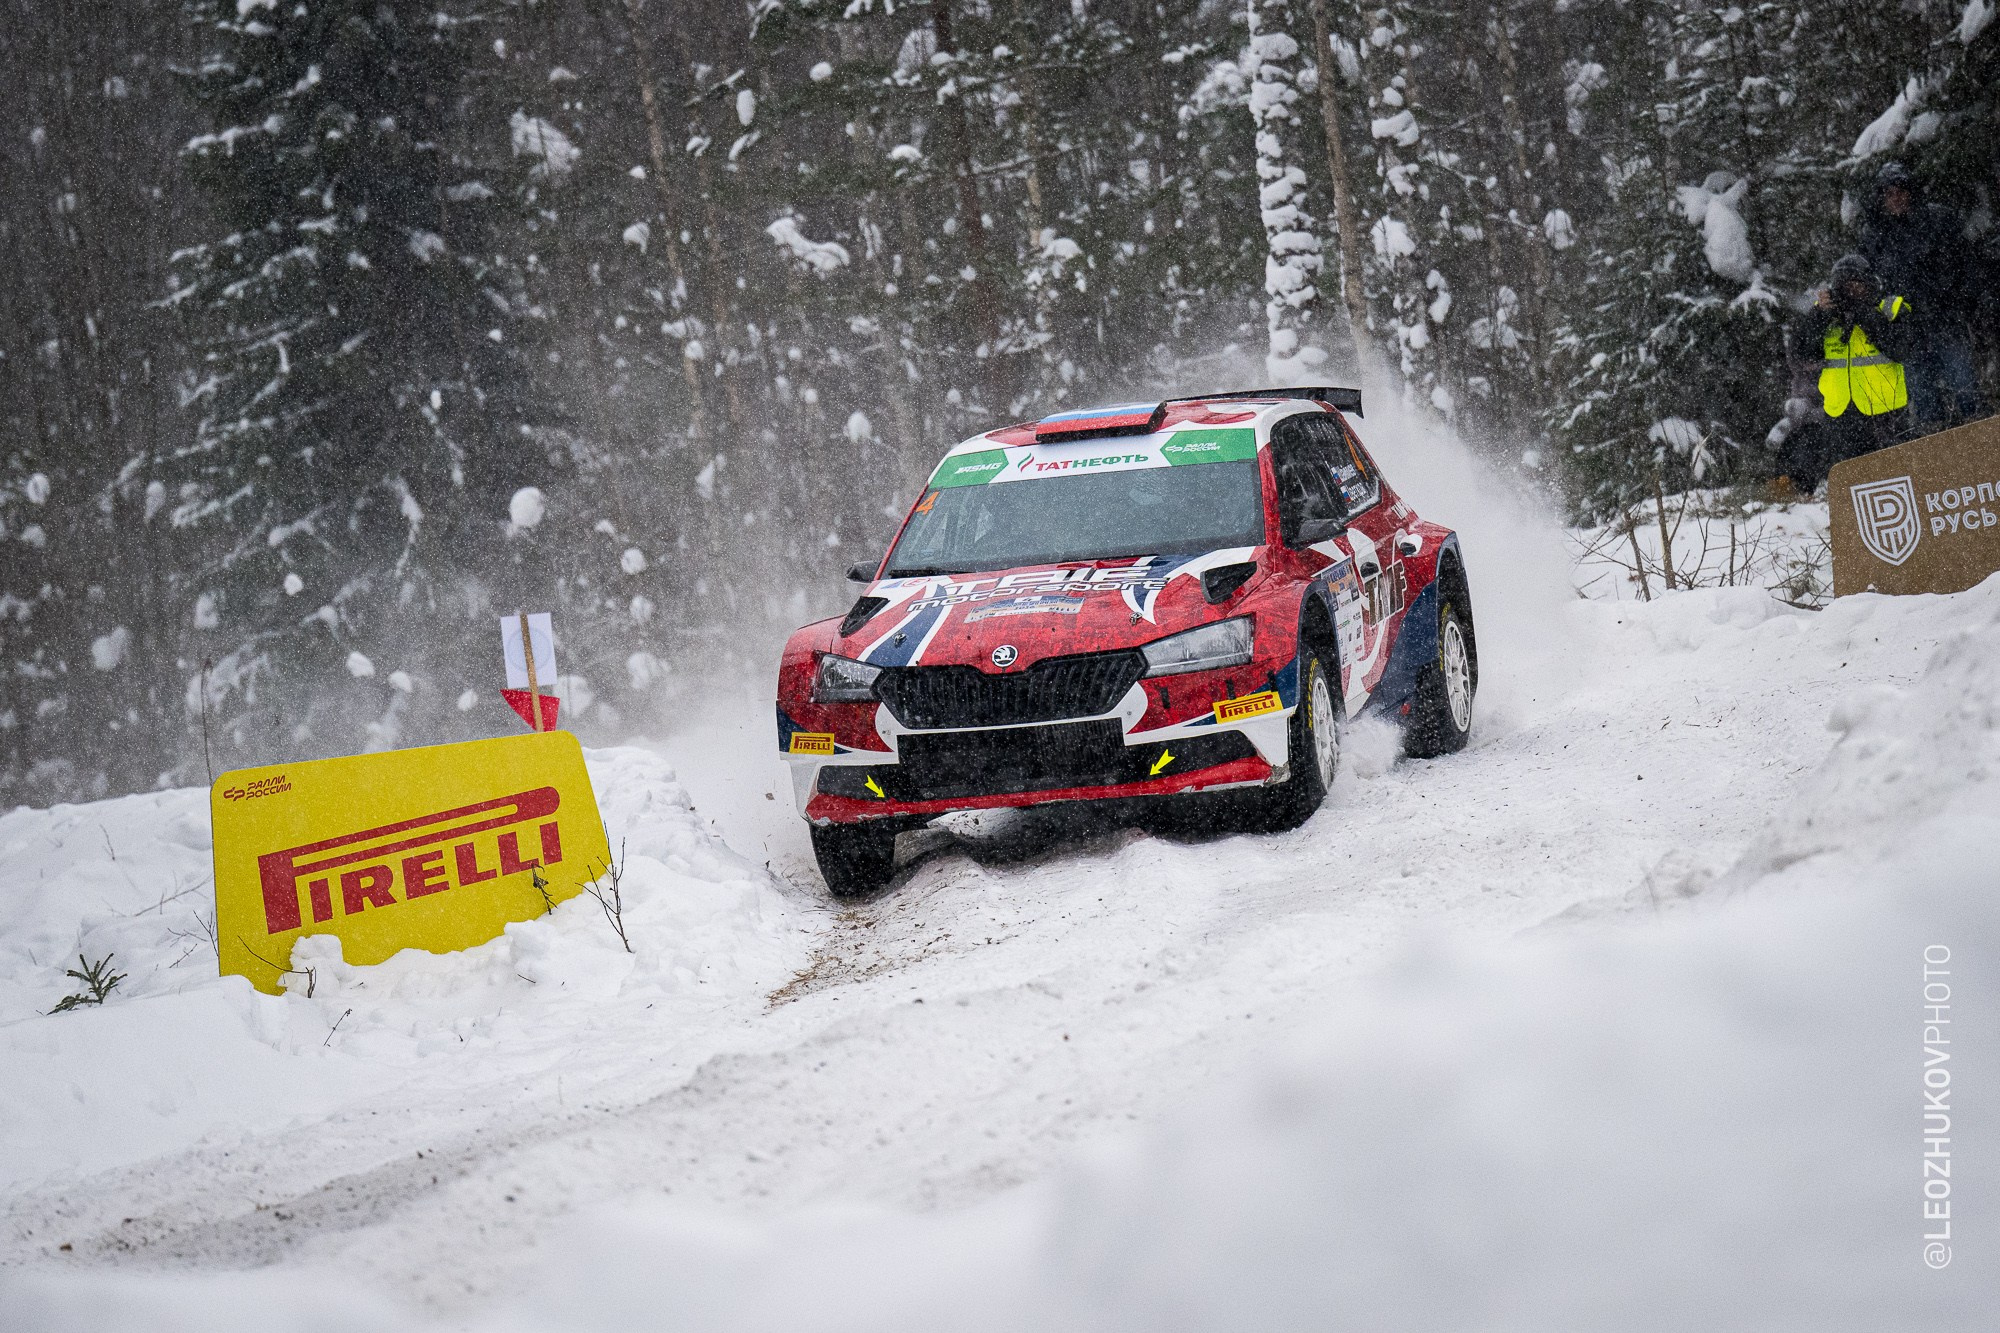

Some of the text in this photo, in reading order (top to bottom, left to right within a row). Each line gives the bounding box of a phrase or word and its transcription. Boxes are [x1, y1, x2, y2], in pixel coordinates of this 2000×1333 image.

[1035, 452, 1149, 472] ТАТНЕФТЬ
[916, 491, 940, 515] 4
[1930, 507, 1997, 537] РУСЬ
[907, 577, 1167, 613] motorsport
[1218, 693, 1280, 721] PIRELLI
[791, 734, 833, 753] PIRELLI
[245, 782, 292, 800] РОССИИ
[247, 774, 286, 791] РАЛЛИ
[258, 786, 563, 934] PIRELLI
